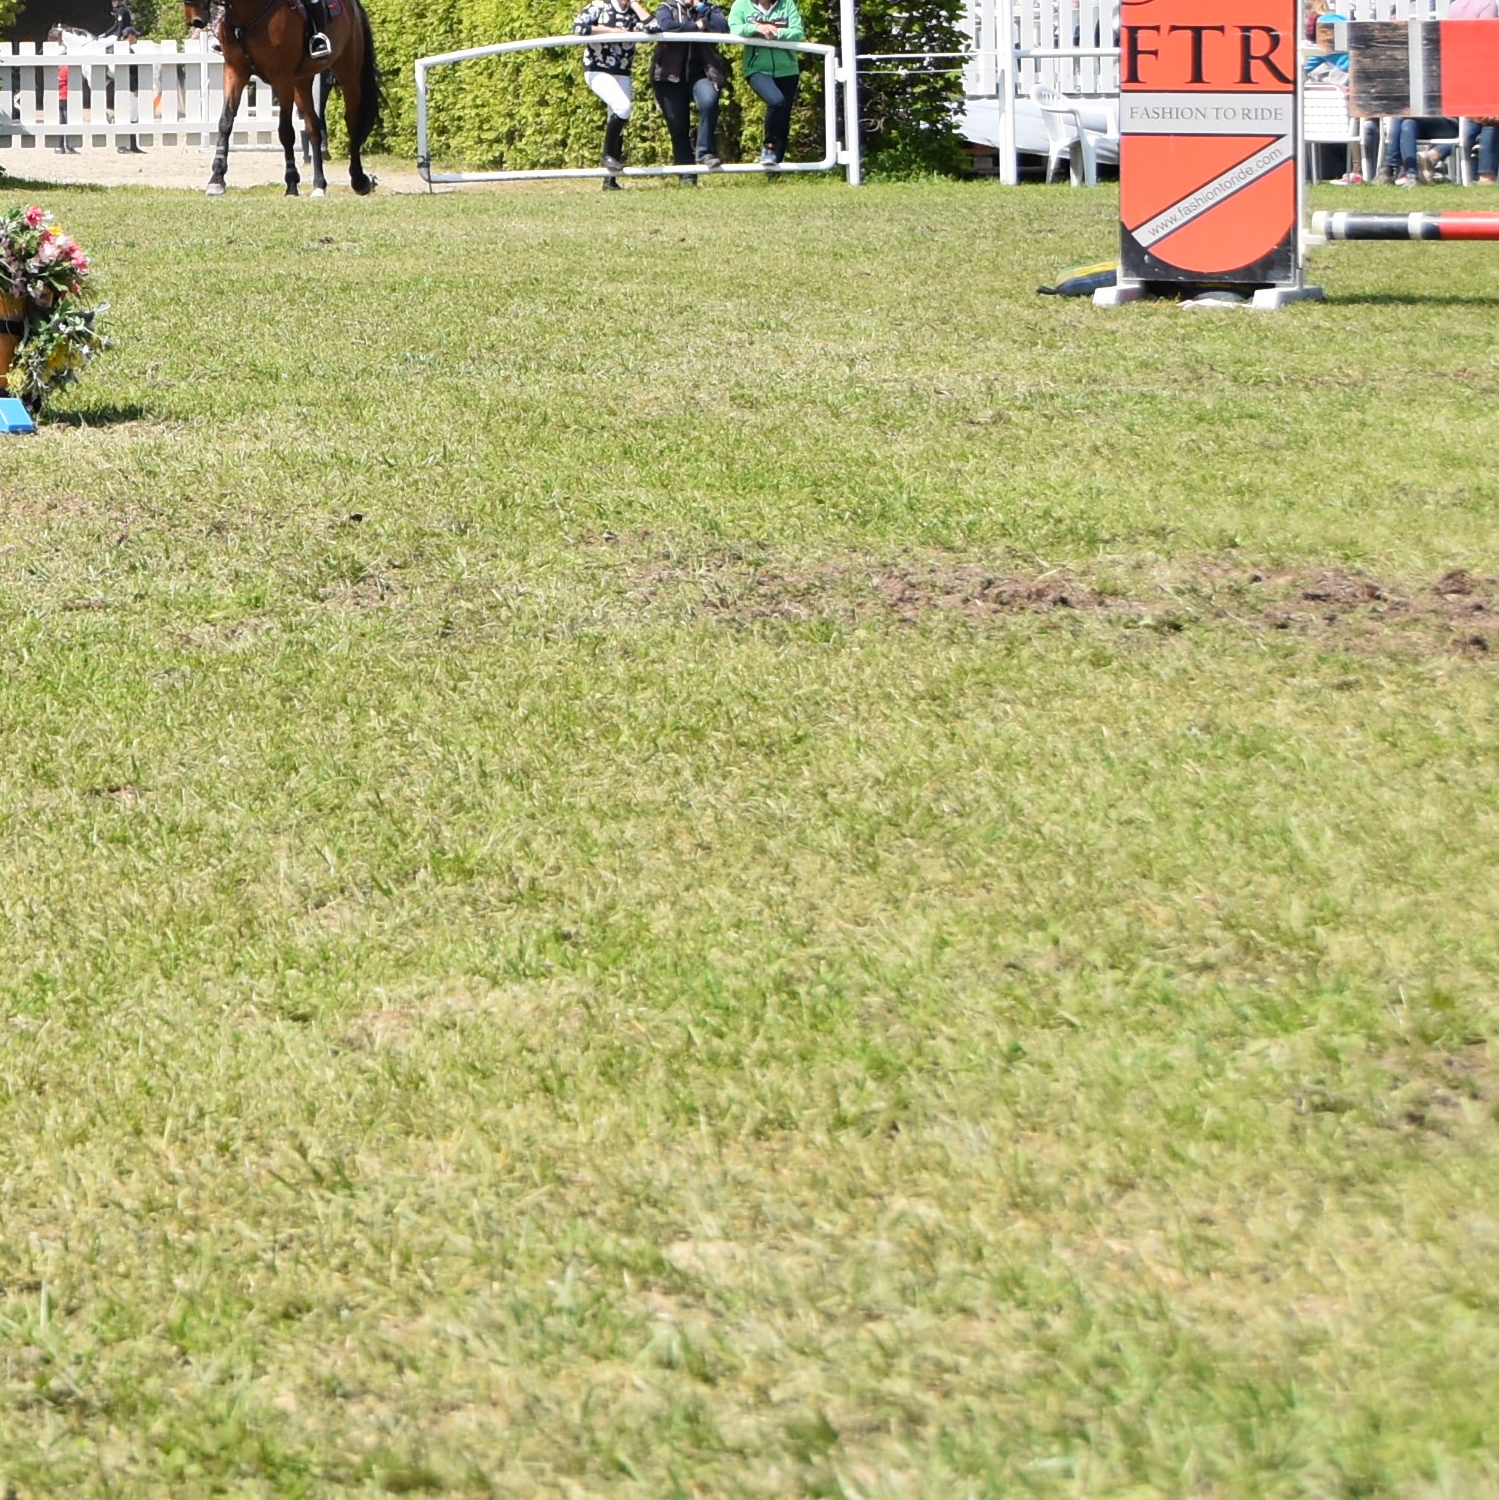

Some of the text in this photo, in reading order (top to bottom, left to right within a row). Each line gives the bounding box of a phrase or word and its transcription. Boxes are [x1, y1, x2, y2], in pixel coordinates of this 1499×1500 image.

[1120, 24, 1294, 85] FTR
[1129, 106, 1284, 122] FASHION TO RIDE
[1147, 147, 1283, 238] www.fashiontoride.com
